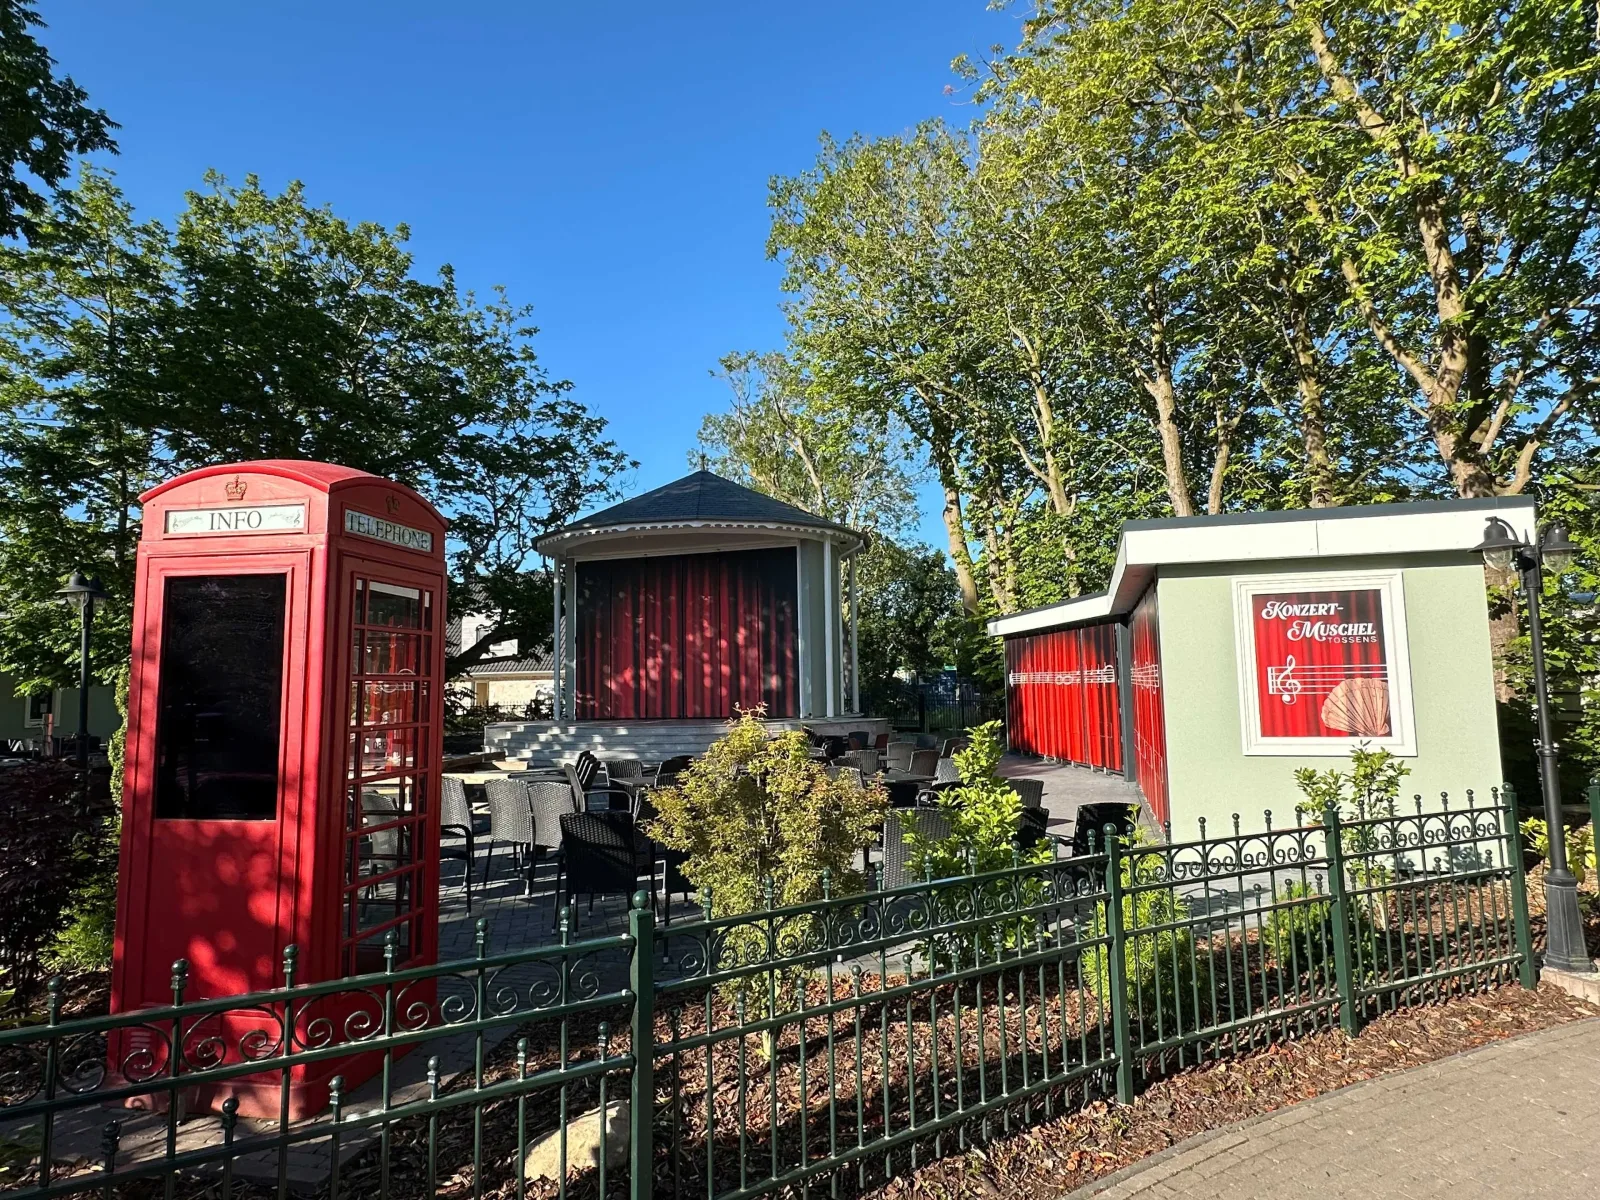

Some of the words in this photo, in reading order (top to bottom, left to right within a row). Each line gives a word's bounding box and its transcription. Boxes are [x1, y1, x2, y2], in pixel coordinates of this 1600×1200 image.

[209, 510, 262, 531] INFO
[346, 512, 428, 549] TELEPHONE
[1261, 601, 1344, 620] KONZERT-
[1287, 620, 1376, 641] MUSCHEL
[1327, 635, 1377, 644] TOSSENS
